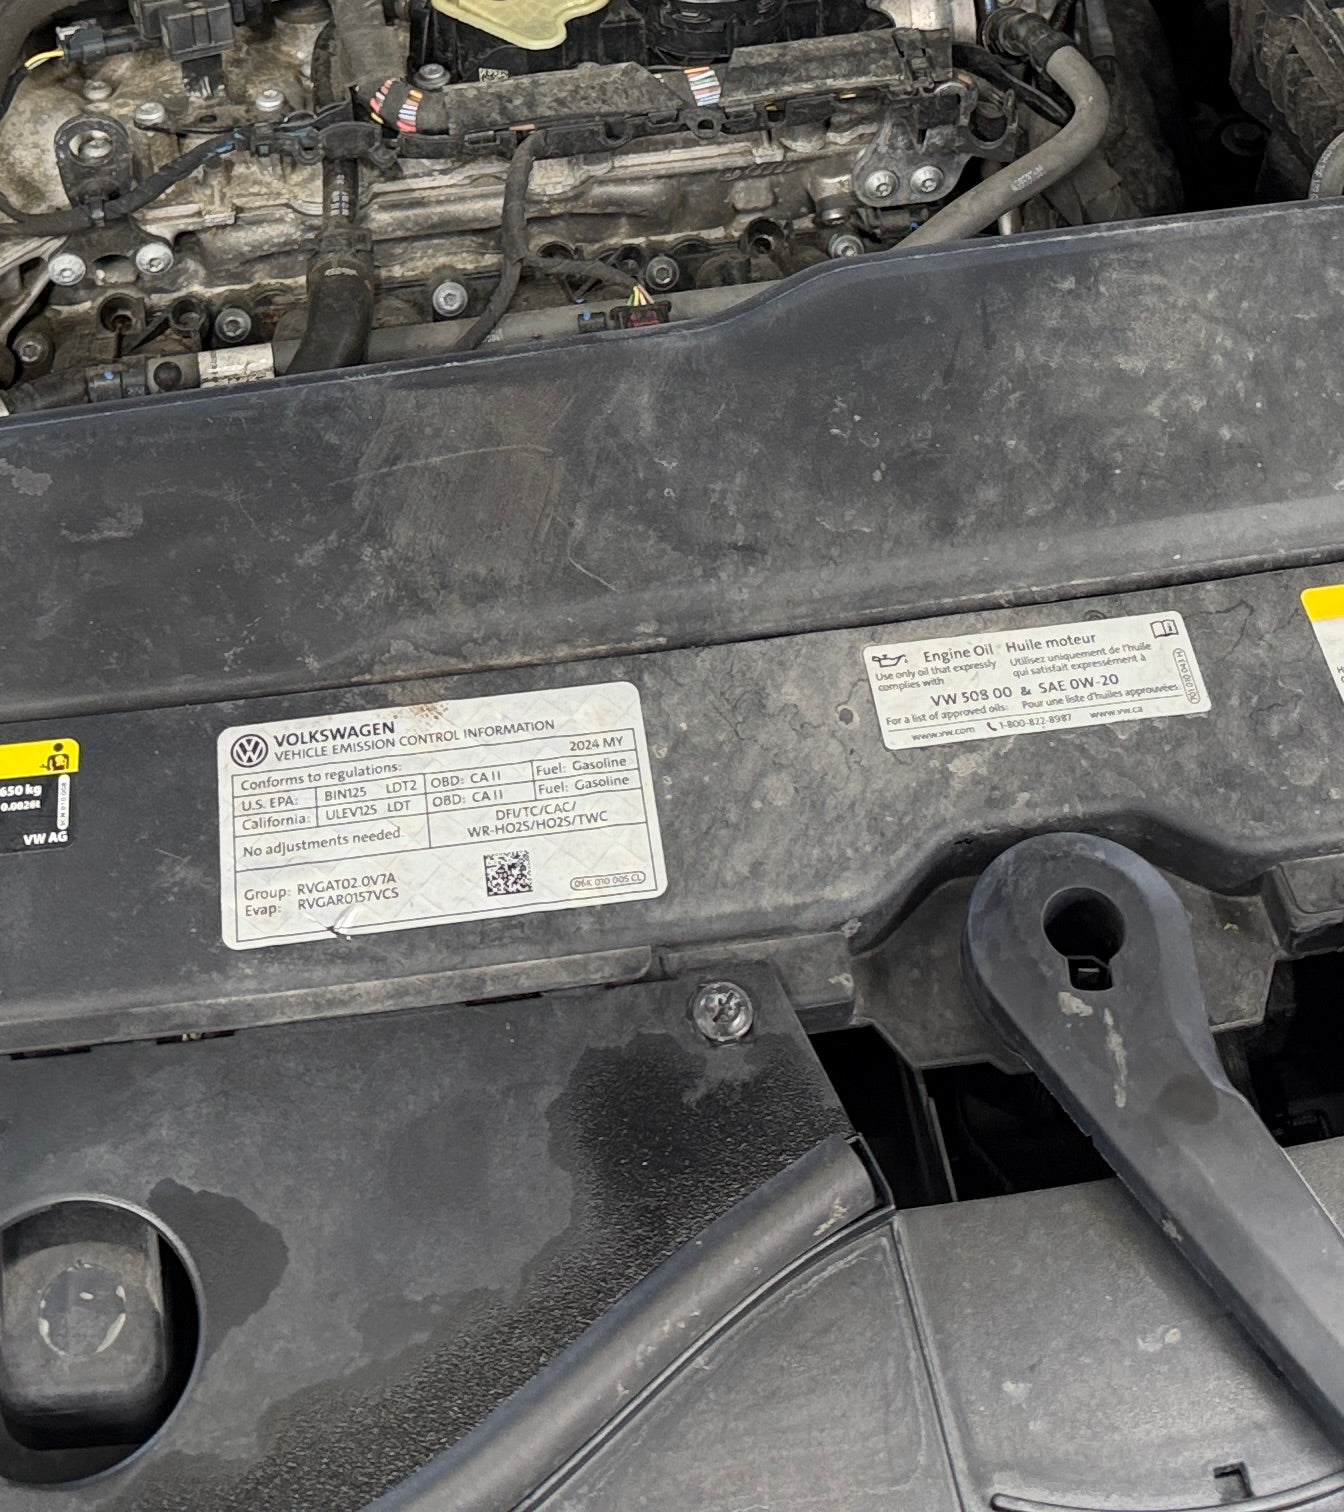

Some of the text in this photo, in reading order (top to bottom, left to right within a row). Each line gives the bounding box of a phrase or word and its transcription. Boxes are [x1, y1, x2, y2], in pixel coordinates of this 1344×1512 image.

[924, 634, 1096, 663] Engine Oil Huile moteur
[1010, 657, 1045, 666] Utilisez
[1048, 648, 1106, 662] uniquement
[896, 670, 915, 680] only
[918, 668, 929, 676] oil
[931, 666, 951, 674] that
[953, 660, 996, 672] expressly
[1013, 669, 1028, 679] qui
[1032, 663, 1069, 674] satisfait
[1140, 653, 1146, 661] à
[878, 677, 944, 691] complies with
[930, 674, 1119, 706] VW 508 00 & SAE 0W-20
[1022, 700, 1043, 709] Pour
[1046, 697, 1064, 706] une
[1065, 694, 1085, 703] liste
[886, 717, 901, 726] For
[912, 714, 926, 722] list
[929, 711, 938, 720] of
[942, 705, 986, 719] approved
[999, 713, 1072, 729] 1-800-822-8987
[1090, 706, 1143, 718] www.vw.ca
[274, 721, 395, 747] VOLKSWAGEN
[275, 719, 555, 762] VEHICLE EMISSION CONTROL INFORMATION
[570, 736, 623, 751] 2024 MY
[912, 726, 975, 741] www.vw.com
[241, 761, 402, 791] Conforms to regulations:
[536, 755, 626, 777] Fuel: Gasoline
[430, 775, 464, 788] OBD:
[470, 772, 489, 783] CA
[538, 774, 629, 795] Fuel: Gasoline
[25, 784, 42, 797] kg
[324, 780, 417, 801] BIN125 LDT2
[432, 794, 465, 807] OBD:
[472, 790, 491, 802] CA
[241, 795, 298, 811] U.S. EPA:
[325, 800, 410, 820] ULEV125 LDT
[243, 814, 309, 831] California:
[467, 810, 608, 838] WR-HO2S/HO2S/TWC
[23, 831, 68, 845] VW AG
[243, 834, 349, 858] No adjustments
[244, 886, 291, 905] Group:
[245, 887, 399, 919] Evap: RVGAR0157VCS
